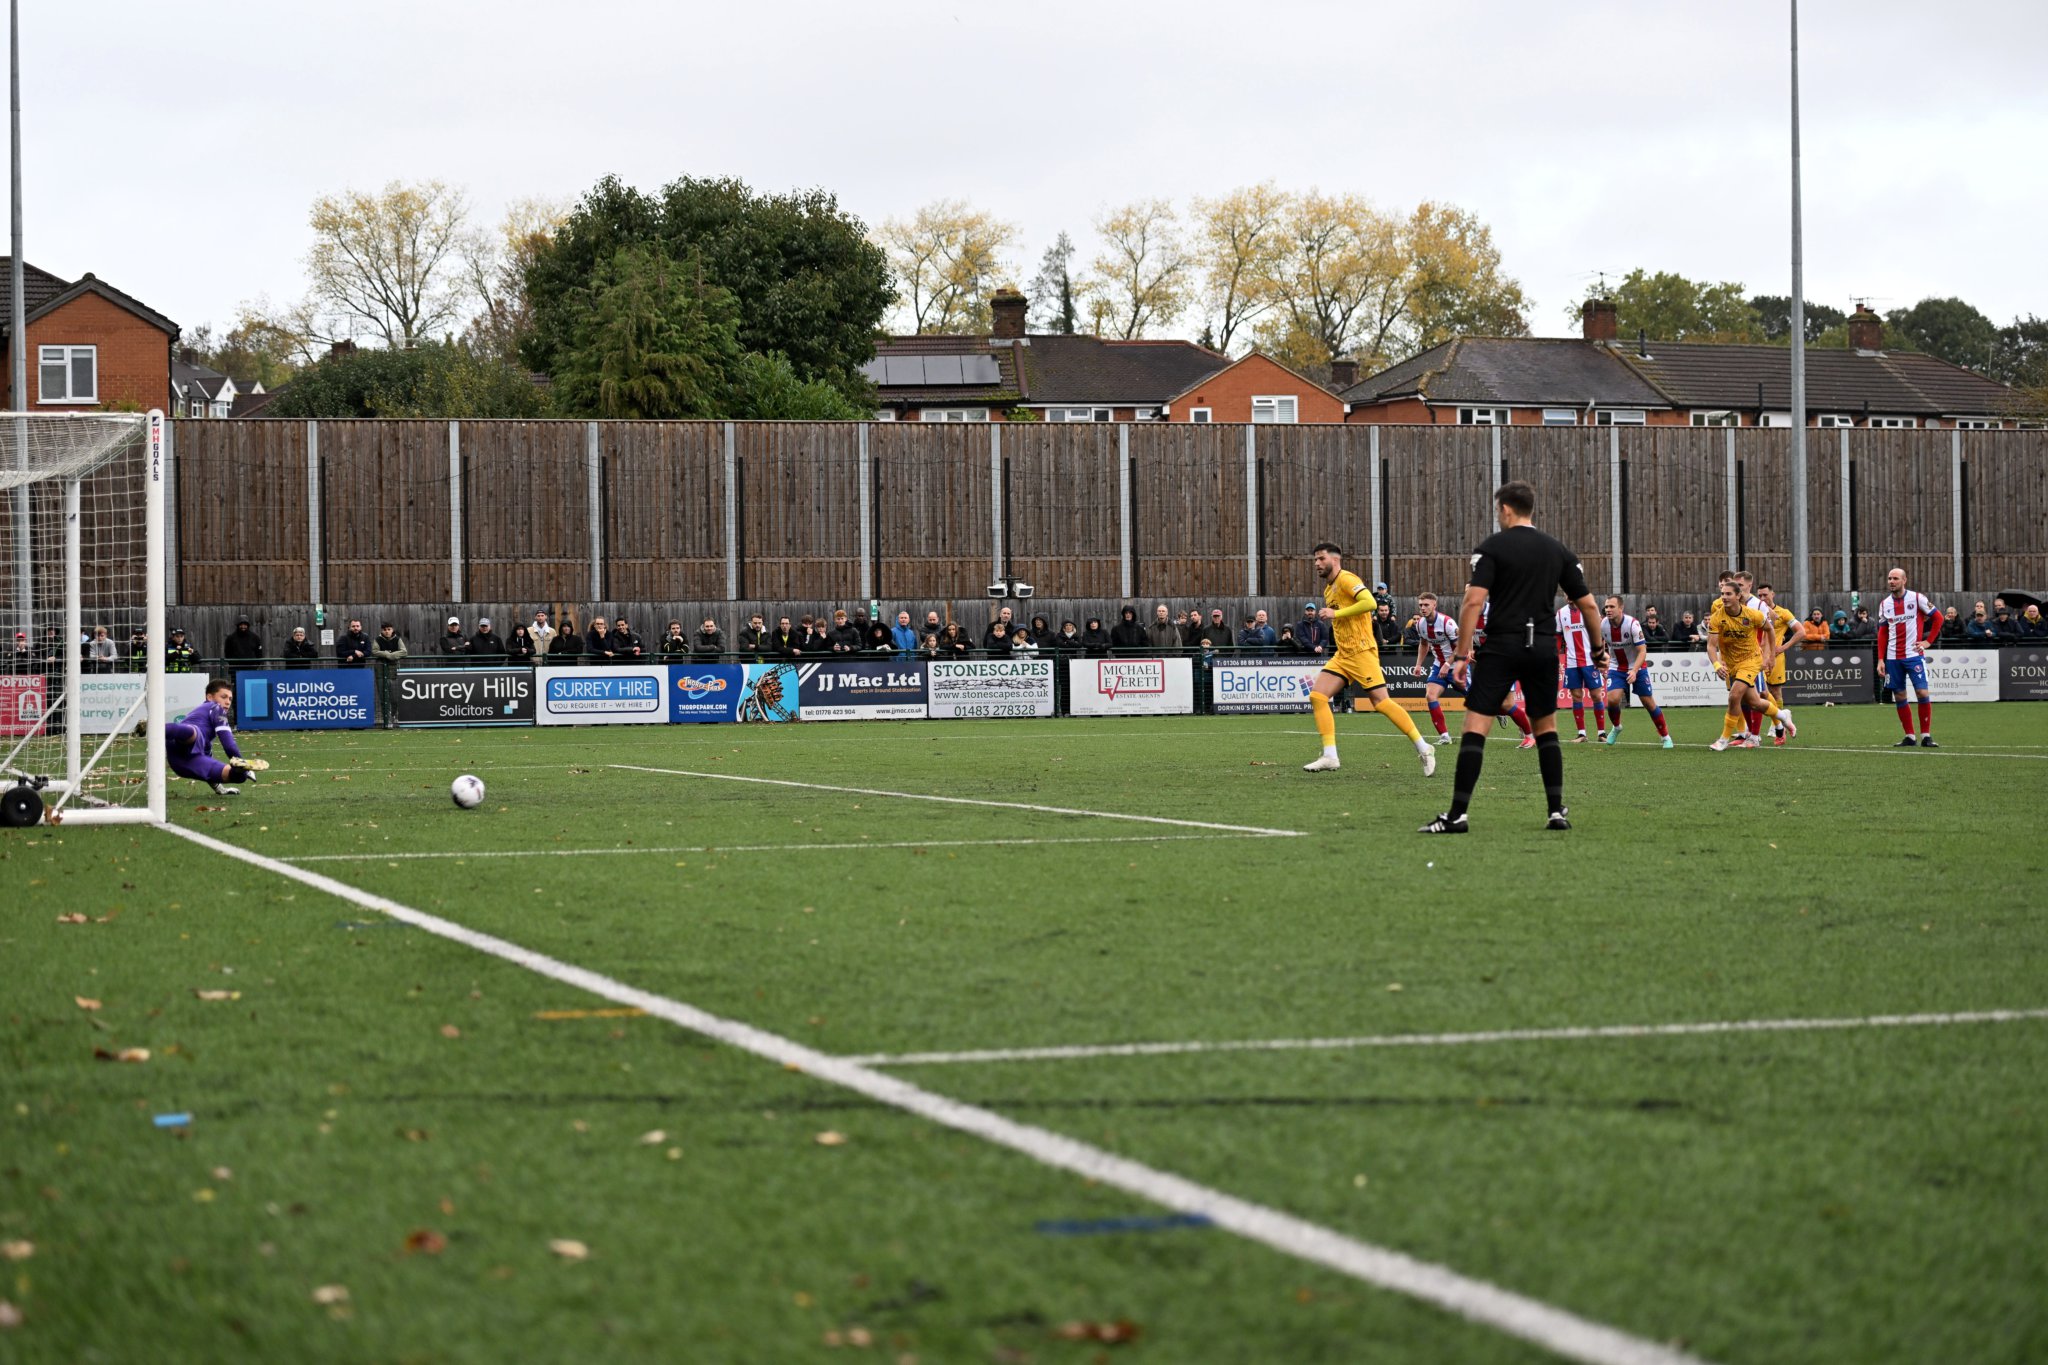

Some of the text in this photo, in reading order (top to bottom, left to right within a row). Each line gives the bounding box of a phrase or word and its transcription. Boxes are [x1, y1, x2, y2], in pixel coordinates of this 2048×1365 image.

[933, 663, 1049, 677] STONESCAPES
[1104, 665, 1160, 675] MICHAEL
[1420, 666, 1427, 675] &
[1785, 669, 1862, 680] TONEGATE
[818, 672, 921, 692] JJ Mac Ltd
[1221, 671, 1295, 692] Barkers
[1650, 672, 1720, 682] TONEGAT
[276, 682, 335, 694] SLIDING
[401, 676, 529, 703] Surrey Hills
[554, 681, 652, 698] SURREY HIRE
[934, 689, 1049, 700] www.stonescapes.co.uk
[277, 695, 358, 707] WARDROBE
[277, 709, 367, 721] WAREHOUSE
[439, 705, 494, 717] Solicitors
[954, 705, 1035, 716] 01483 278328
